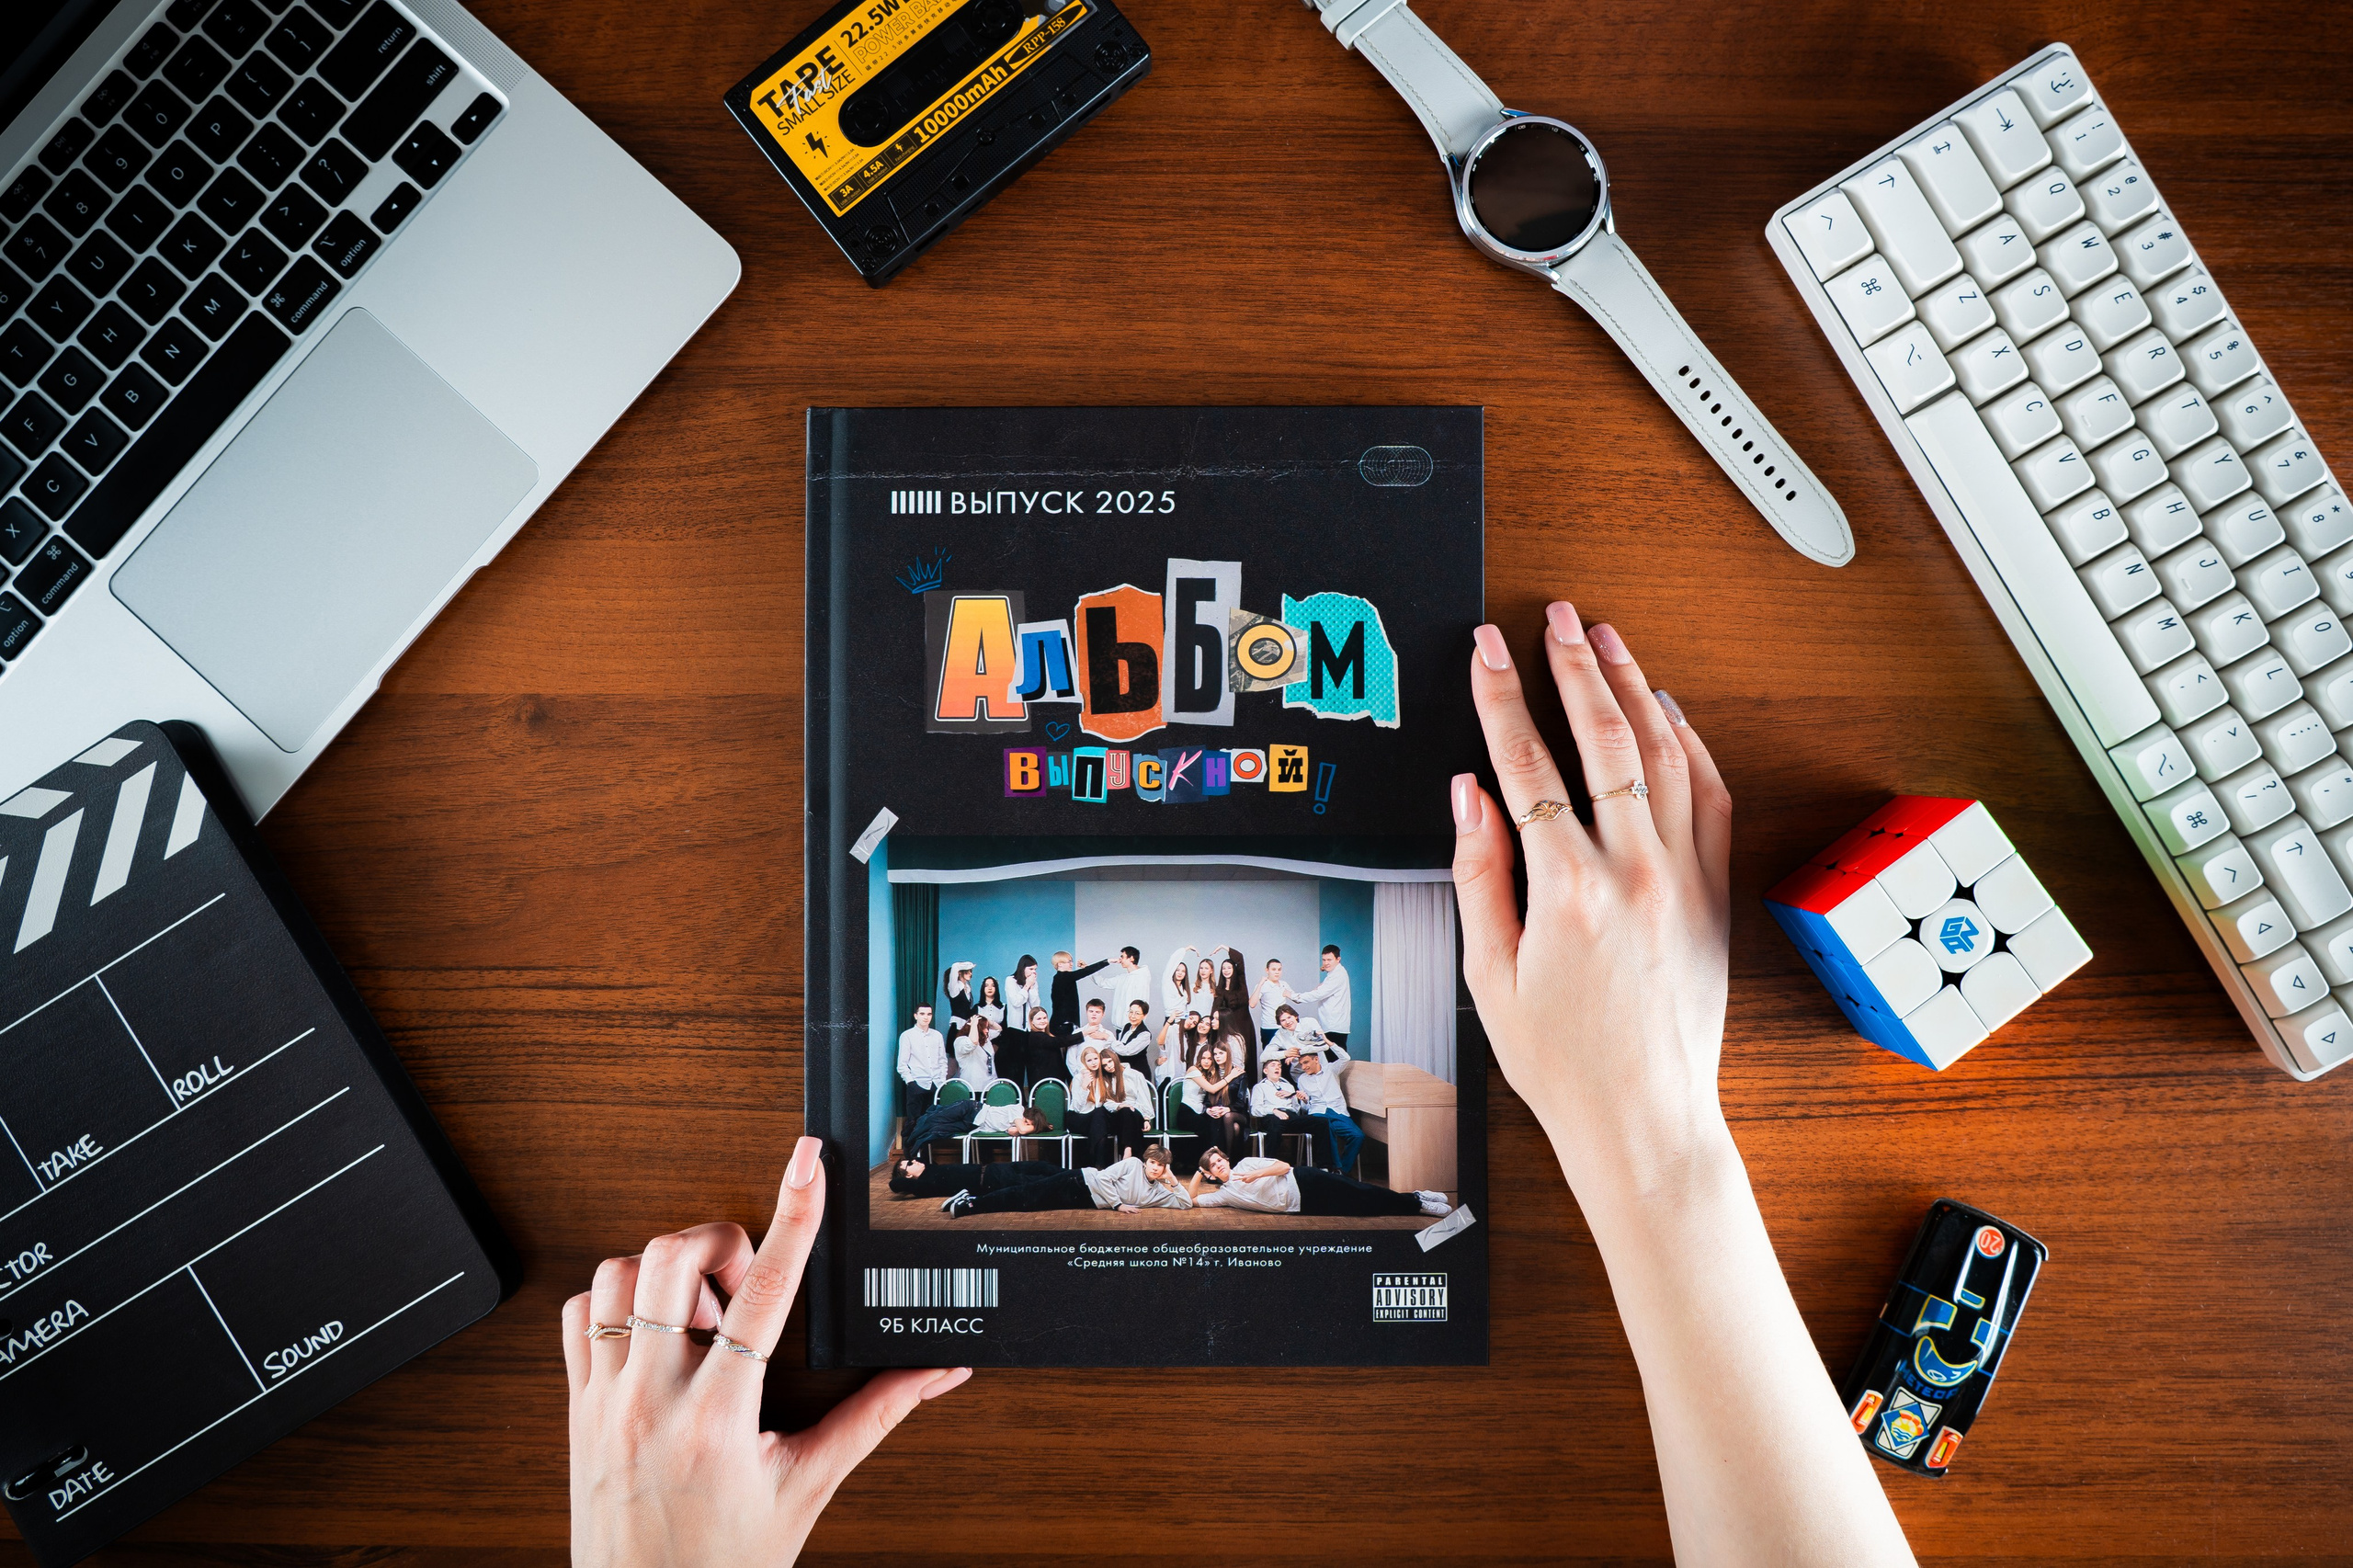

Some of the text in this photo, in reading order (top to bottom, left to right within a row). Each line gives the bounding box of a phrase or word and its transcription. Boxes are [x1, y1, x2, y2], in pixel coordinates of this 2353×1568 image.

[377, 27, 404, 54] return
[852, 11, 915, 64] POWER
[1022, 17, 1066, 55] RPP-158
[426, 63, 447, 86] shift
[756, 44, 846, 119] TAPE
[775, 63, 833, 115] Fast
[777, 68, 857, 136] SMALL SIZE
[913, 64, 1009, 143] 10000mAh
[210, 122, 221, 136] P
[2075, 133, 2086, 142] 1
[116, 157, 128, 170] 9
[863, 160, 884, 179] 4.5A
[839, 184, 854, 198] 3A
[2049, 182, 2066, 195] Q
[2107, 187, 2120, 197] 2
[75, 201, 88, 214] 8
[222, 198, 237, 208] L
[182, 239, 198, 253] K
[1999, 234, 2018, 245] A
[2081, 236, 2100, 249] W
[2142, 242, 2154, 250] 3
[35, 246, 46, 259] 7
[340, 238, 367, 267] option
[90, 256, 105, 270] U
[146, 283, 156, 297] J
[2033, 285, 2051, 297] S
[290, 280, 329, 324] command
[1959, 290, 1978, 304] Z
[2114, 291, 2133, 304] E
[51, 301, 63, 312] Y
[204, 298, 221, 315] M
[102, 327, 118, 343] H
[10, 346, 23, 358] T
[165, 344, 180, 359] N
[1992, 346, 2011, 358] X
[2064, 339, 2084, 352] D
[2147, 347, 2166, 359] R
[2209, 350, 2222, 360] 5
[63, 373, 77, 387] G
[124, 390, 140, 403] B
[2097, 393, 2118, 403] F
[2026, 401, 2043, 412] C
[2181, 398, 2200, 409] T
[2245, 405, 2258, 414] 6
[23, 418, 34, 432] F
[85, 433, 98, 447] V
[2058, 452, 2076, 463] V
[2132, 449, 2150, 461] G
[2214, 453, 2233, 464] Y
[2278, 460, 2290, 468] 7
[46, 479, 60, 493] C
[950, 490, 1176, 515] ВЫПУСК 2025
[2165, 501, 2186, 514] H
[2092, 508, 2110, 520] B
[2248, 509, 2268, 521] U
[2312, 514, 2325, 523] 8
[5, 523, 21, 539] X
[2125, 562, 2144, 575] N
[2199, 559, 2218, 568] J
[41, 562, 79, 605] command
[2157, 617, 2177, 631] M
[2233, 612, 2252, 625] K
[3, 619, 29, 648] option
[2266, 667, 2283, 680] L
[172, 1055, 234, 1101] ROLL
[37, 1133, 104, 1181] TAKE
[975, 1243, 1373, 1256] Муниципальное бюджетное общеобразовательное учреждение
[1067, 1256, 1126, 1269] «Средняя
[1130, 1259, 1168, 1268] школа
[1214, 1259, 1223, 1268] г.
[1227, 1256, 1282, 1268] Иваново
[1376, 1277, 1443, 1286] PARENTAL
[1375, 1288, 1445, 1307] ADVISORY
[1375, 1309, 1445, 1319] EXPLICIT CONTENT
[879, 1317, 984, 1334] 9Б КЛАСС
[263, 1320, 345, 1379] SOUND
[48, 1460, 115, 1510] DATE
